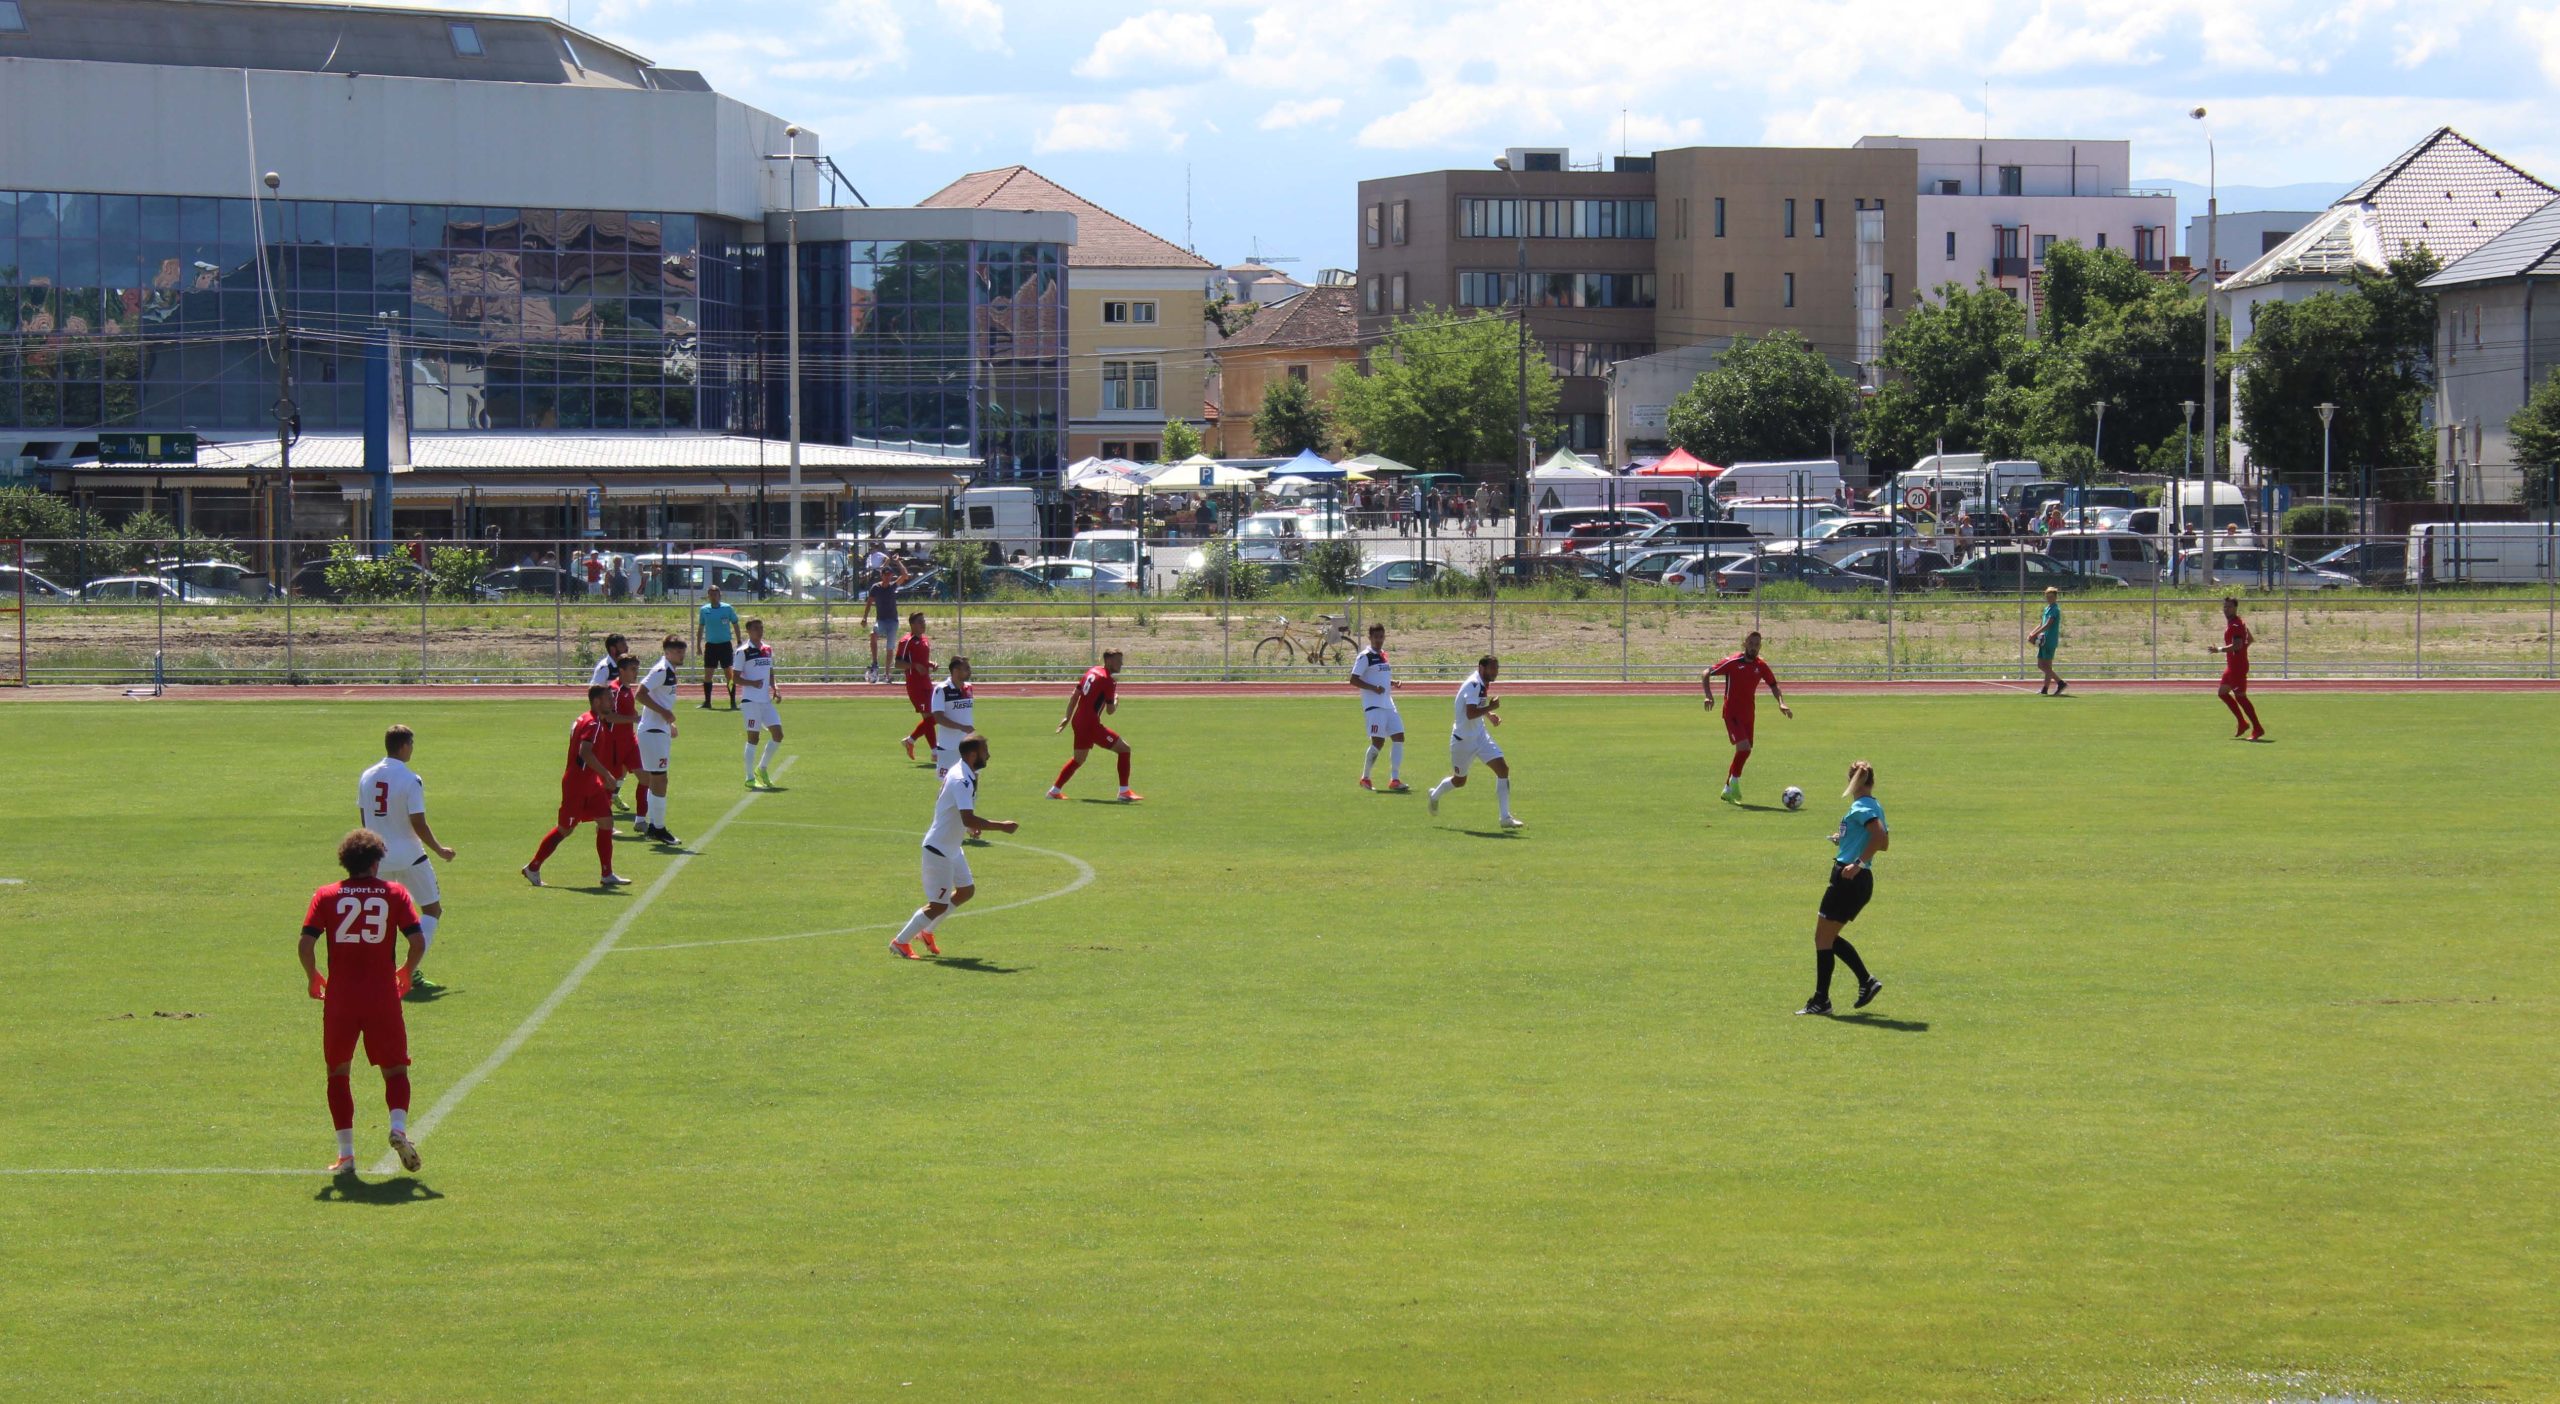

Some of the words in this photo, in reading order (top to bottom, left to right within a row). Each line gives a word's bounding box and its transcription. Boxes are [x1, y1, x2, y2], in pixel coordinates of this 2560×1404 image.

[129, 437, 145, 460] Play
[1202, 468, 1211, 480] P
[1911, 493, 1925, 505] 20
[1082, 673, 1096, 696] 6
[374, 781, 389, 817] 3
[939, 887, 947, 899] 7
[335, 897, 389, 944] 23
